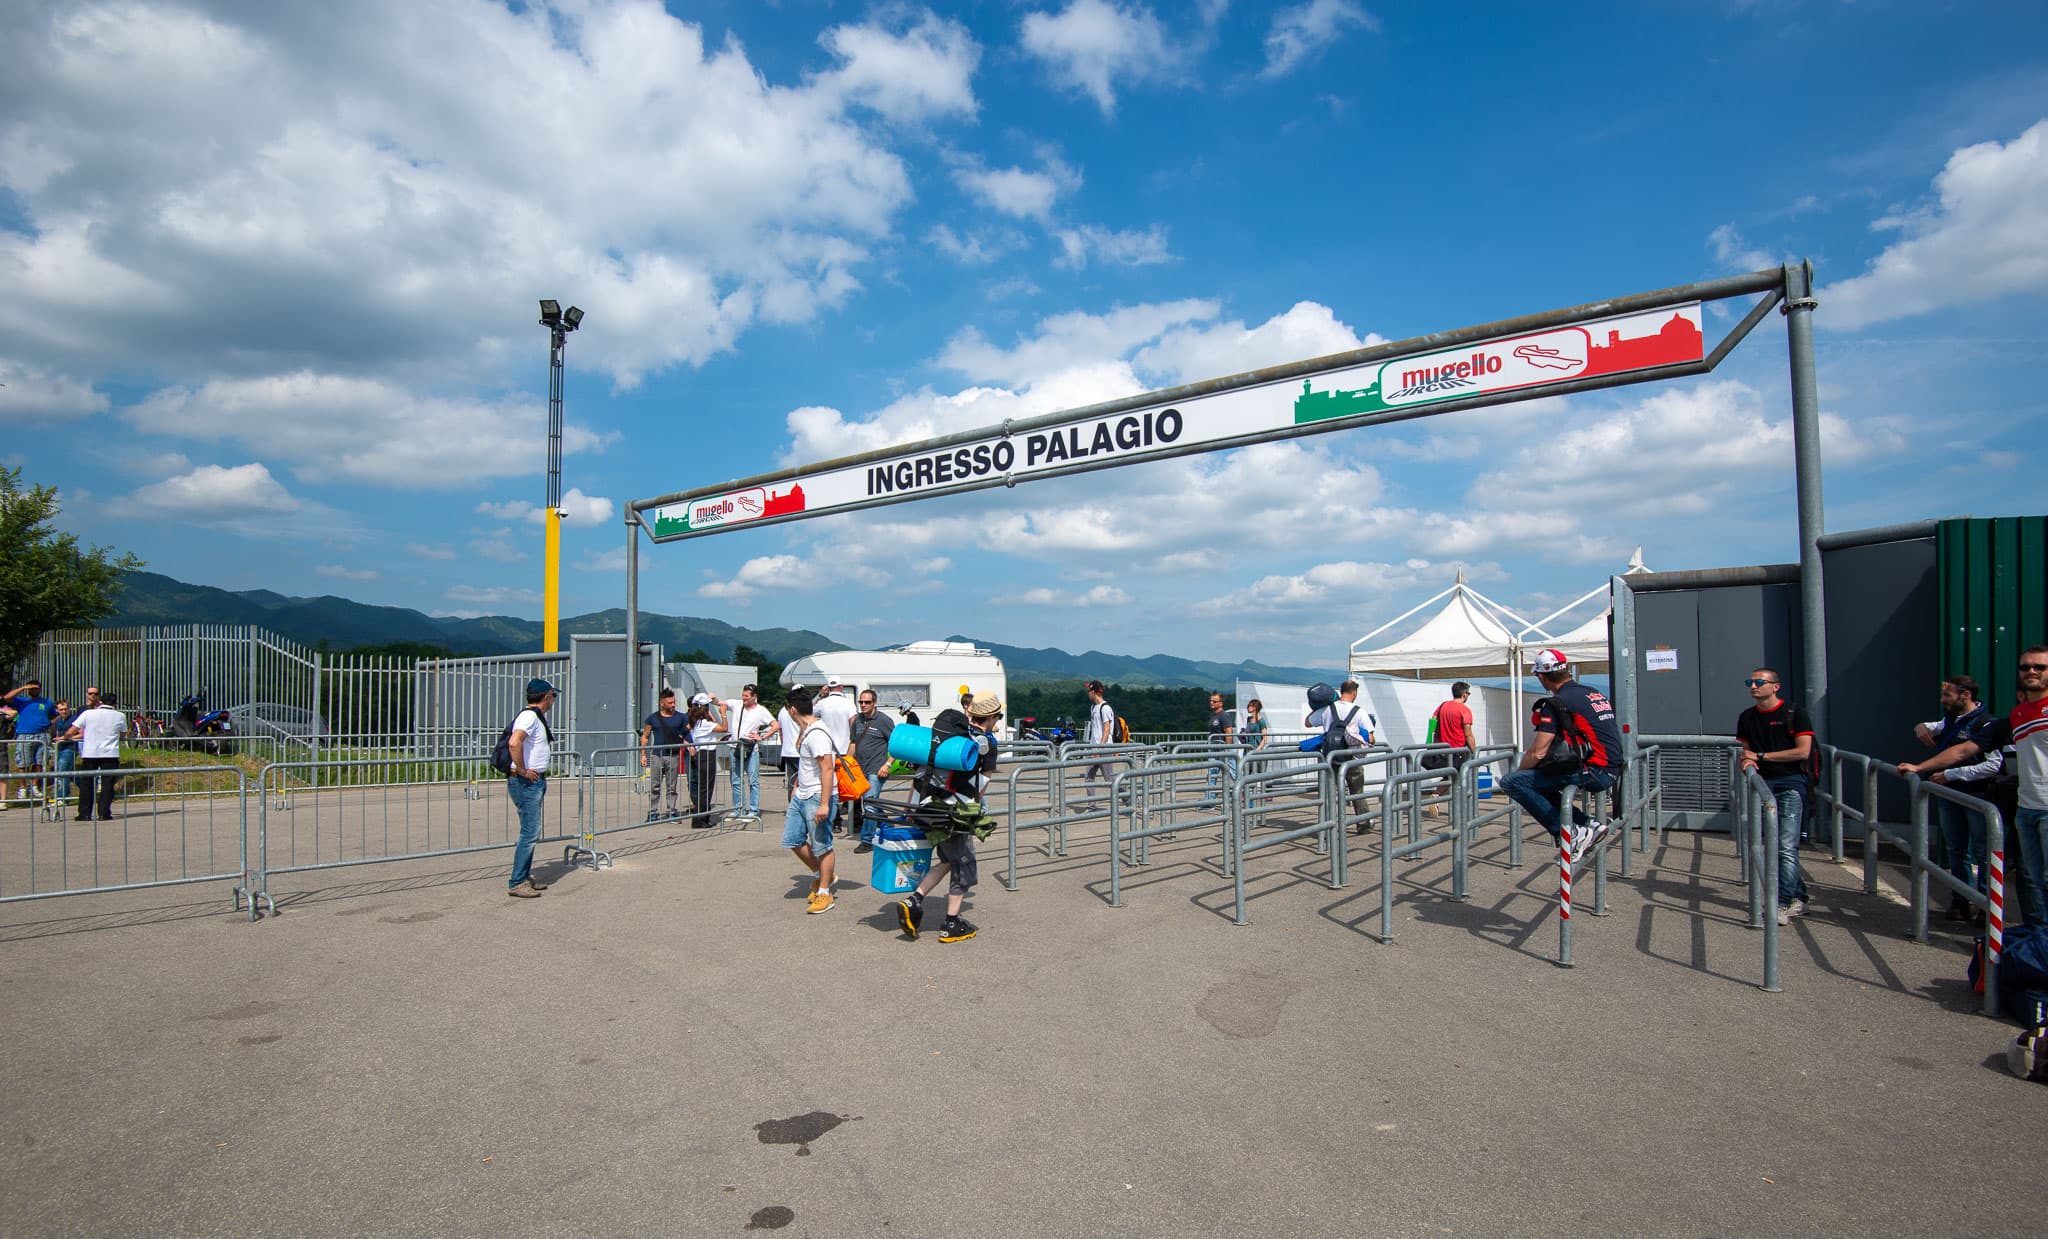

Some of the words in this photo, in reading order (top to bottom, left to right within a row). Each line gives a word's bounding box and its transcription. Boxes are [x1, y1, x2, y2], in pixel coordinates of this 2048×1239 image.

[1402, 353, 1502, 388] mugello
[1386, 378, 1477, 399] CIRCUIT
[867, 441, 1015, 495] INGRESSO
[1027, 409, 1183, 466] PALAGIO
[696, 499, 734, 518] mugello
